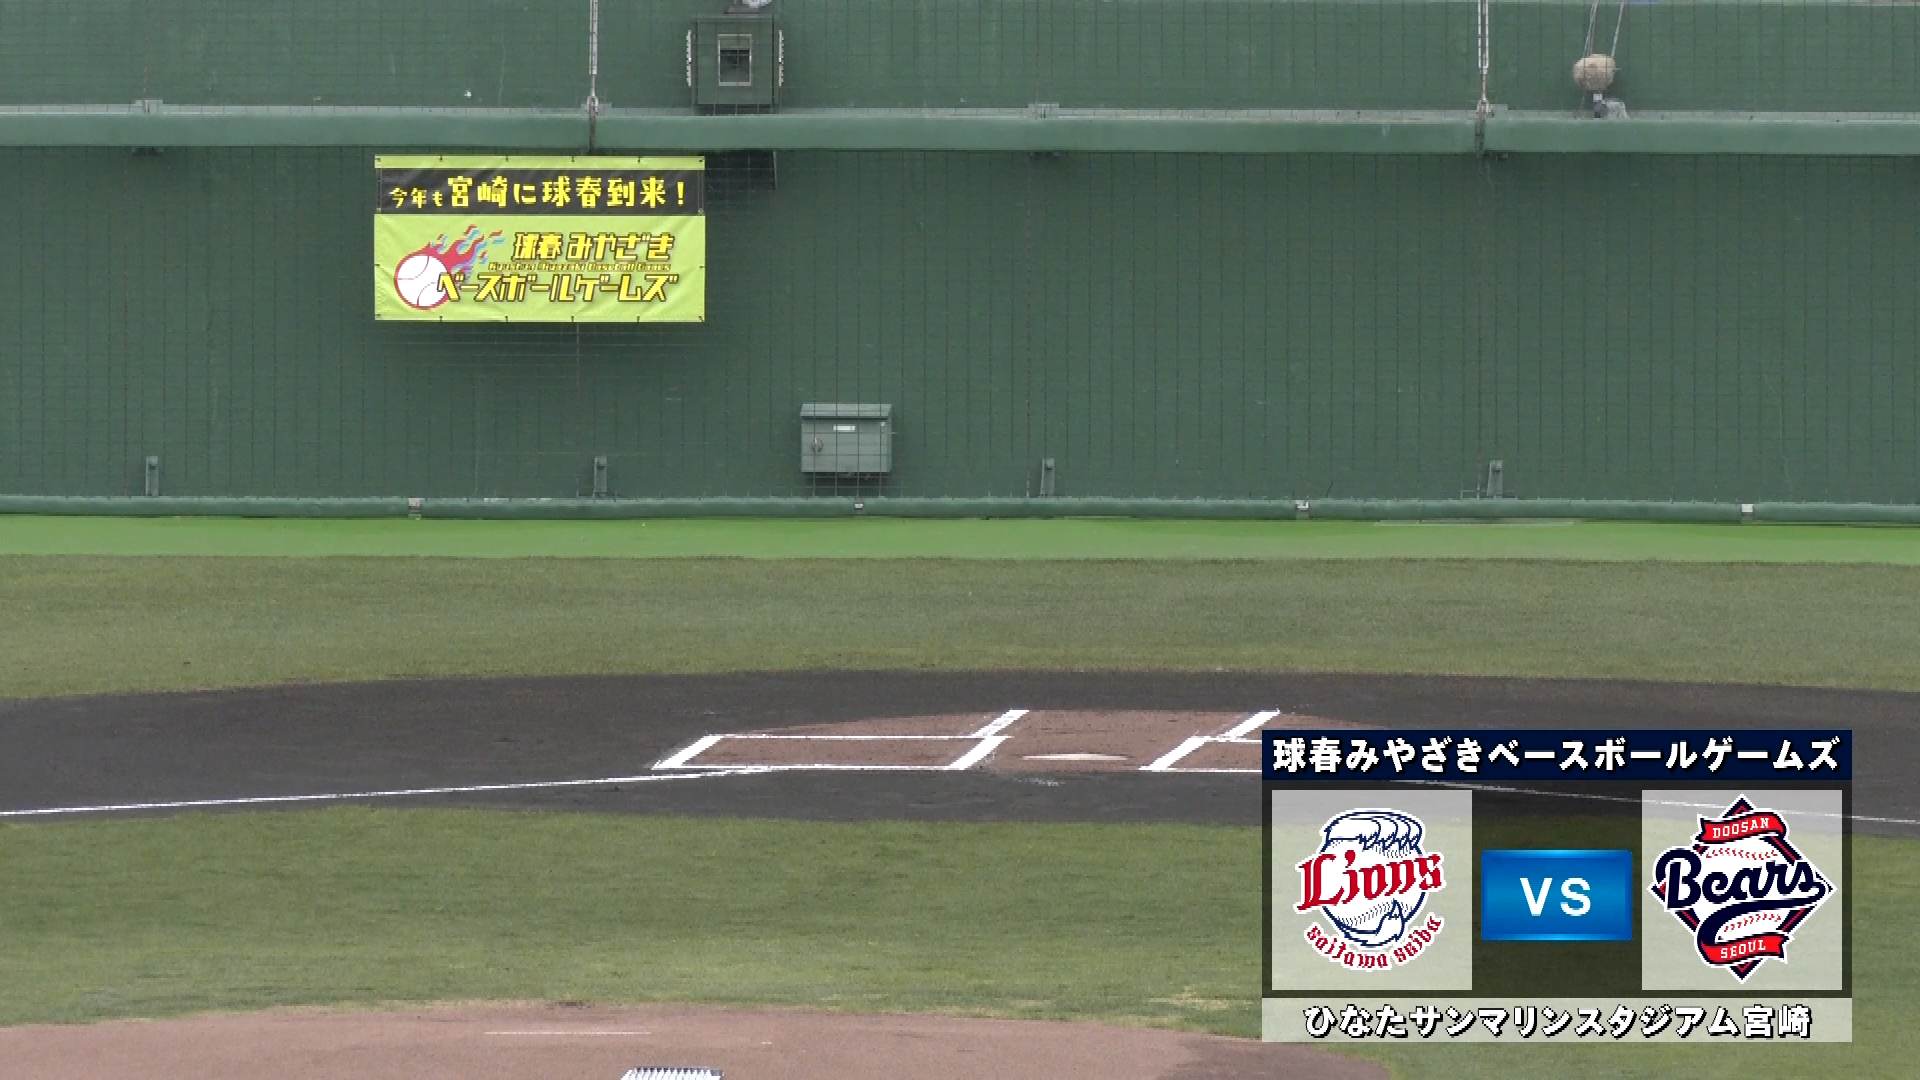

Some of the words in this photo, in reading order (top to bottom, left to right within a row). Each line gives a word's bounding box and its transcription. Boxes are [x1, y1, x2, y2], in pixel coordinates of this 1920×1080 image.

[436, 273, 680, 302] ベースボールゲームズ
